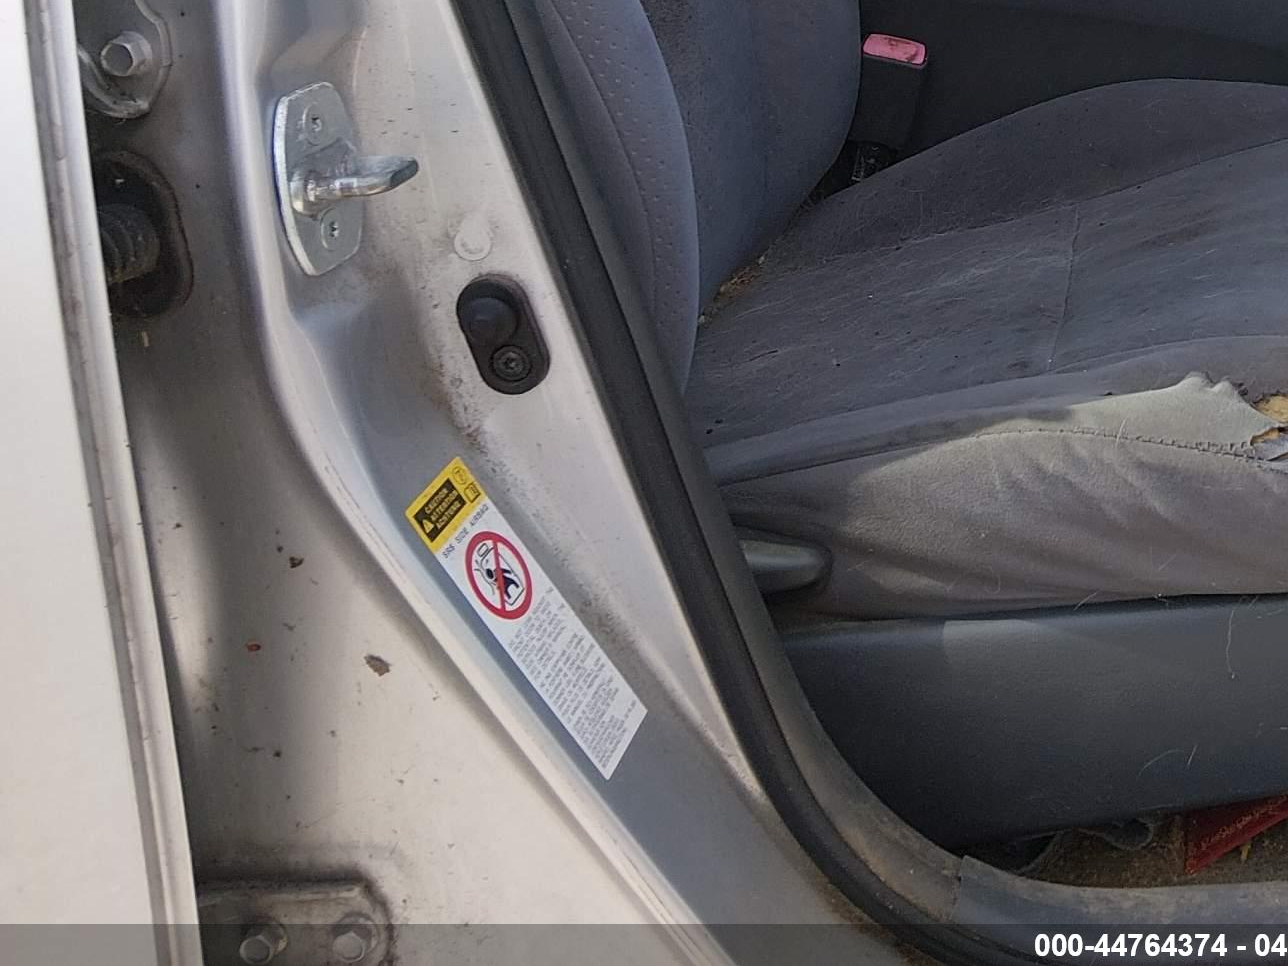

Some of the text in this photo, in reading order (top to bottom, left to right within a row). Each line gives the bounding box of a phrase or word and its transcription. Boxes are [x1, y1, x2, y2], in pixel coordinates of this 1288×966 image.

[424, 487, 448, 515] CAUTION
[454, 526, 469, 544] SIDE
[468, 502, 489, 527] AIRBAG
